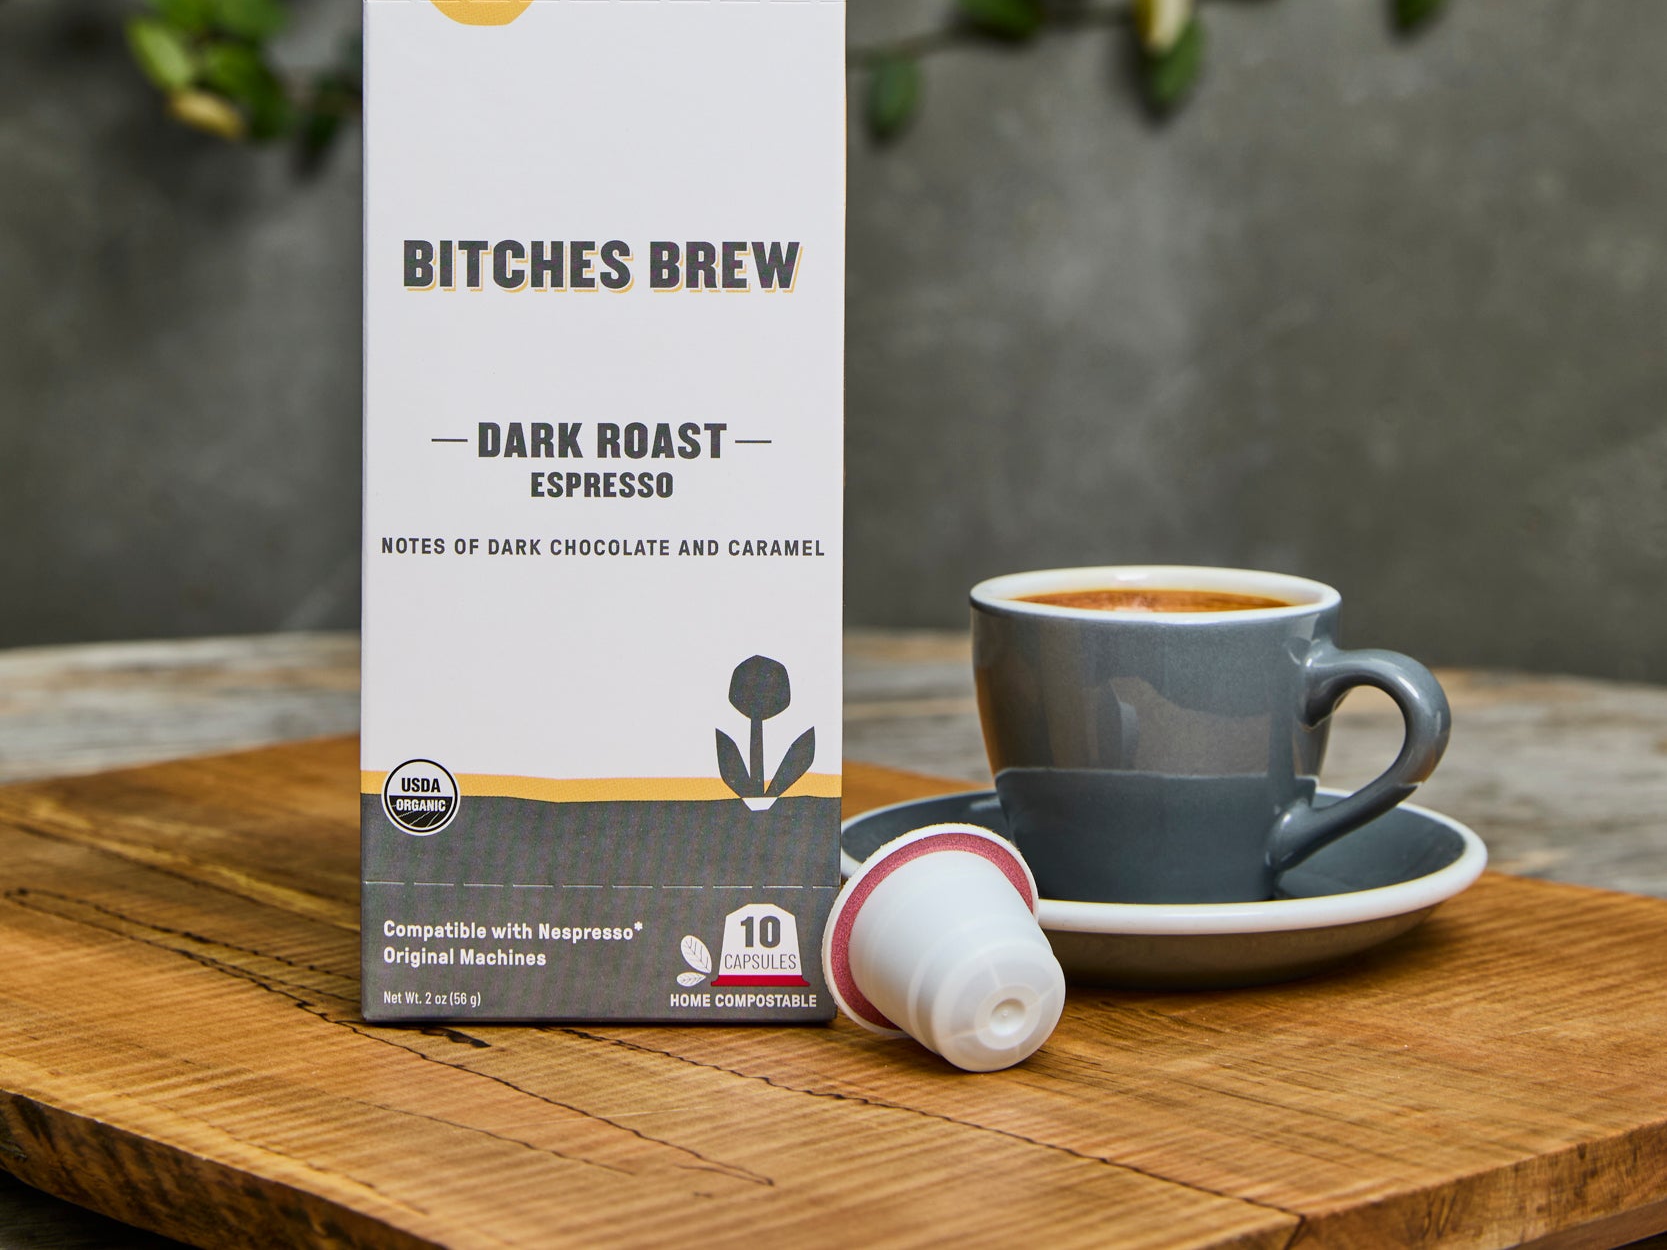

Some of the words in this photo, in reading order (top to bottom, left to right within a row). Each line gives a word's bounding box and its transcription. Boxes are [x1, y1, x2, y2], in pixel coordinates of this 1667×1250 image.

[403, 239, 635, 294] BITCHES
[649, 241, 803, 294] BREW
[477, 422, 583, 459] DARK
[597, 422, 727, 460] ROAST
[530, 472, 674, 498] ESPRESSO
[381, 537, 446, 555] NOTES
[454, 538, 479, 555] OF
[488, 538, 542, 556] DARK
[550, 539, 670, 556] CHOCOLATE
[678, 540, 719, 557] AND
[728, 540, 825, 557] CARAMEL
[401, 777, 441, 793] USDA
[395, 798, 446, 813] ORGANIC
[383, 920, 486, 944] Compatible
[491, 922, 533, 940] with
[740, 915, 781, 948] 10
[383, 947, 454, 970] Original
[459, 948, 546, 967] Machines
[723, 953, 797, 970] CAPSULES
[383, 991, 401, 1005] Net
[404, 991, 422, 1005] Wt.
[425, 992, 432, 1005] 2
[435, 995, 447, 1006] oz
[449, 991, 468, 1007] (56
[470, 991, 481, 1008] g)
[670, 994, 711, 1008] HOME
[715, 994, 817, 1008] COMPOSTABLE
